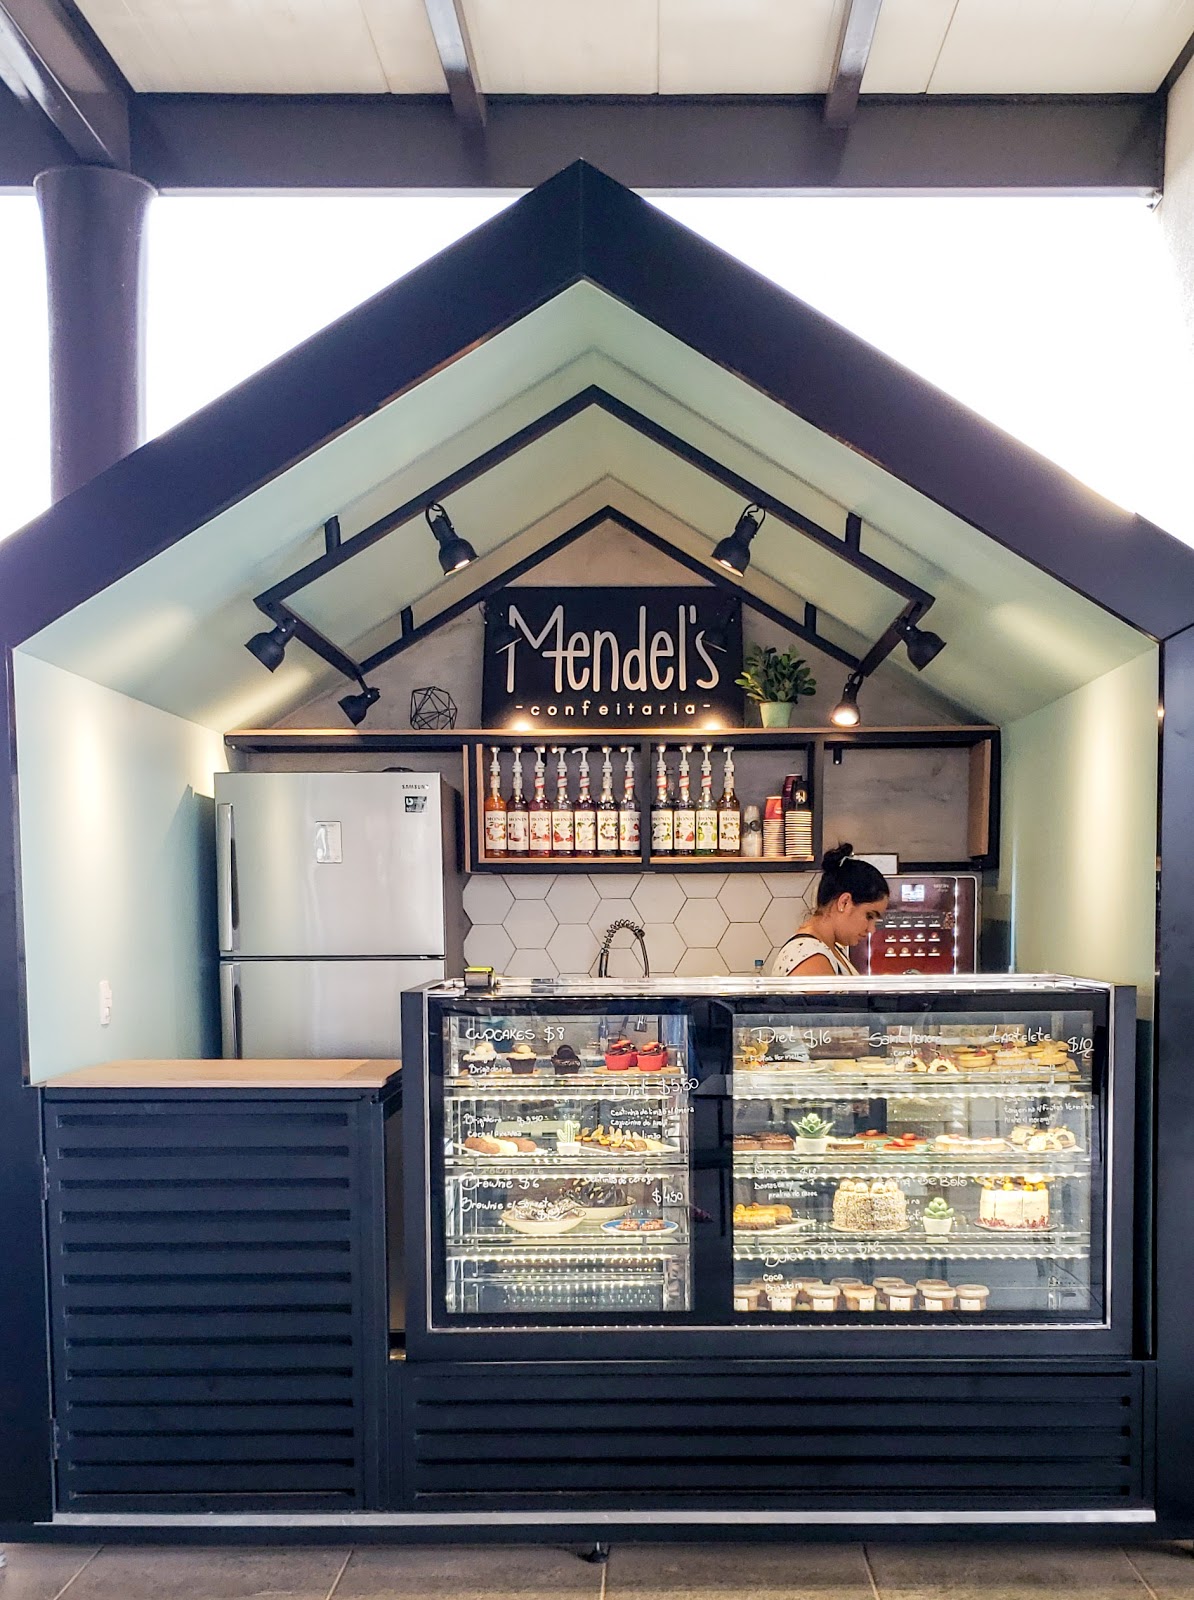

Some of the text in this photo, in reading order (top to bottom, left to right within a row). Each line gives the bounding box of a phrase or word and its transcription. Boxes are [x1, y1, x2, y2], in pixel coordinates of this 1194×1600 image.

[506, 604, 719, 693] Mendel's
[543, 1025, 566, 1043] $8
[750, 1025, 832, 1048] Diet $16
